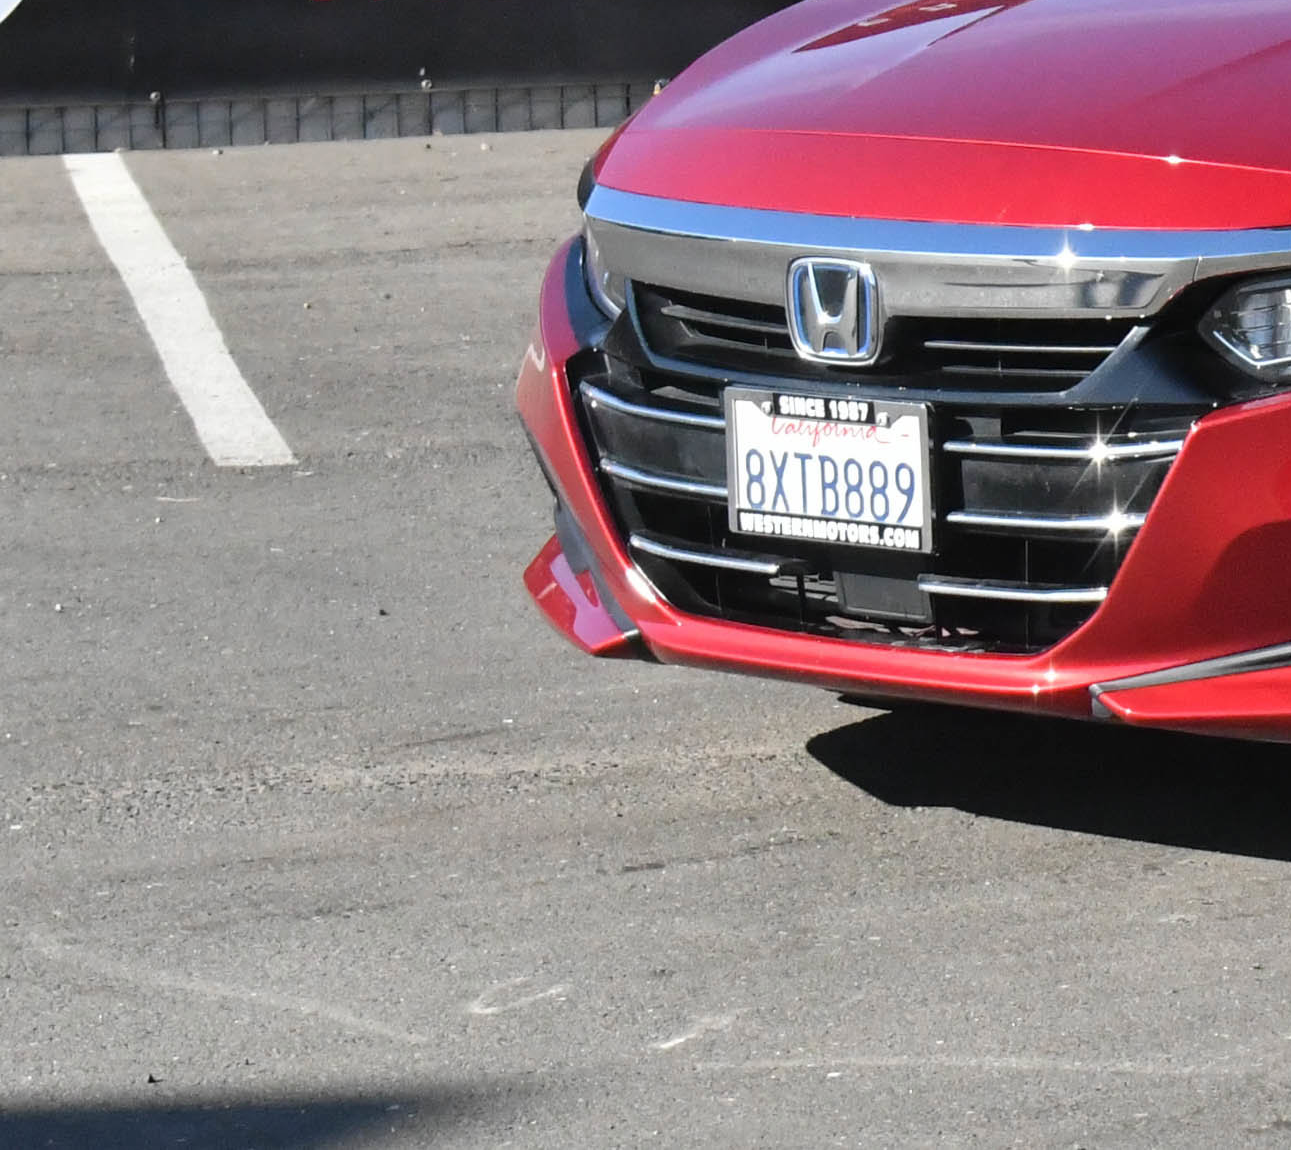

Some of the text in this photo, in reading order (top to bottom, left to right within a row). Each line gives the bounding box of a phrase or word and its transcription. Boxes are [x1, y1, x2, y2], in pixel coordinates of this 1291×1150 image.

[779, 395, 826, 418] SINCE
[745, 449, 915, 523] 8XTB889
[739, 512, 920, 549] WESTERNMOTORS.COM
